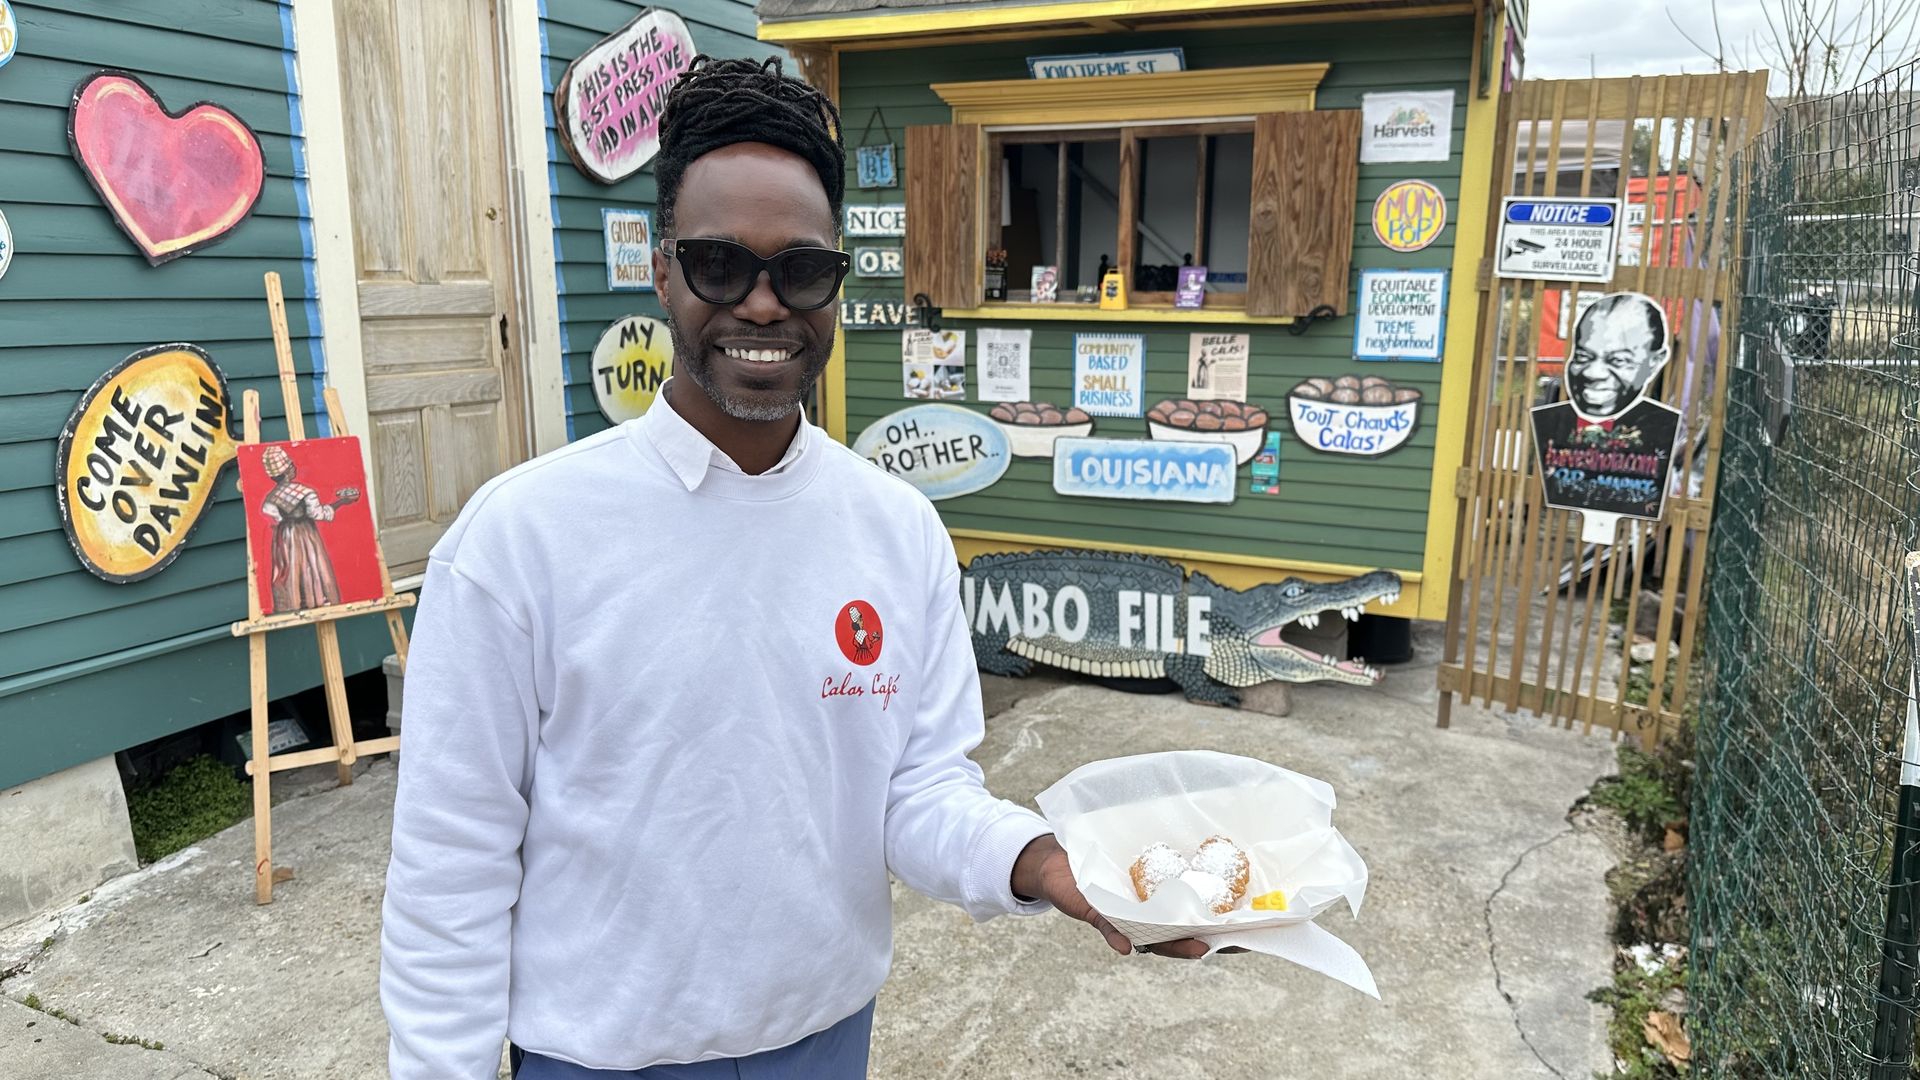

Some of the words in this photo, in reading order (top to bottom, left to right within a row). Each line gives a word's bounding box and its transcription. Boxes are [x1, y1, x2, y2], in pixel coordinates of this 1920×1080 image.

[577, 63, 612, 103] HIS
[611, 53, 629, 78] IS
[629, 26, 662, 65] THE
[581, 95, 612, 142] BST
[615, 64, 654, 107] PRESS
[656, 44, 684, 76] I'VE
[620, 111, 637, 140] IN
[639, 104, 652, 129] A
[1373, 124, 1436, 139] Harvest
[864, 153, 890, 180] BE
[1386, 188, 1438, 222] MOM
[1529, 204, 1591, 223] NOTICE
[611, 220, 649, 245] GLUTEN
[1389, 218, 1433, 244] POP
[1578, 229, 1604, 237] UNDER
[616, 244, 643, 264] free
[1555, 238, 1569, 249] 24
[1571, 239, 1602, 250] HOUR
[859, 251, 902, 272] OR
[1560, 250, 1594, 261] VIDEO
[1531, 261, 1600, 272] SURVEILLANCE
[1370, 279, 1437, 293] EQUITABLE
[1371, 293, 1432, 305] ECONOMIC
[840, 302, 920, 325] LEAVE
[1367, 304, 1437, 316] DEVELOPMENT
[619, 321, 654, 351] MY
[1375, 320, 1417, 335] TREME
[1078, 343, 1136, 356] COMMUNITY
[1201, 334, 1237, 346] BELLE
[1365, 334, 1435, 352] neighborhood
[1088, 355, 1129, 371] BASED
[598, 359, 666, 395] TURN
[1083, 375, 1130, 392] SMALL
[1079, 390, 1134, 407] BUSINESS
[77, 384, 143, 511] COME
[1319, 427, 1384, 451] Calas!
[112, 404, 185, 524] OVER
[1064, 456, 1229, 487] LOUISIANA
[1118, 590, 1212, 657] FILE
[821, 672, 865, 699] Calas
[871, 673, 901, 711] Café
